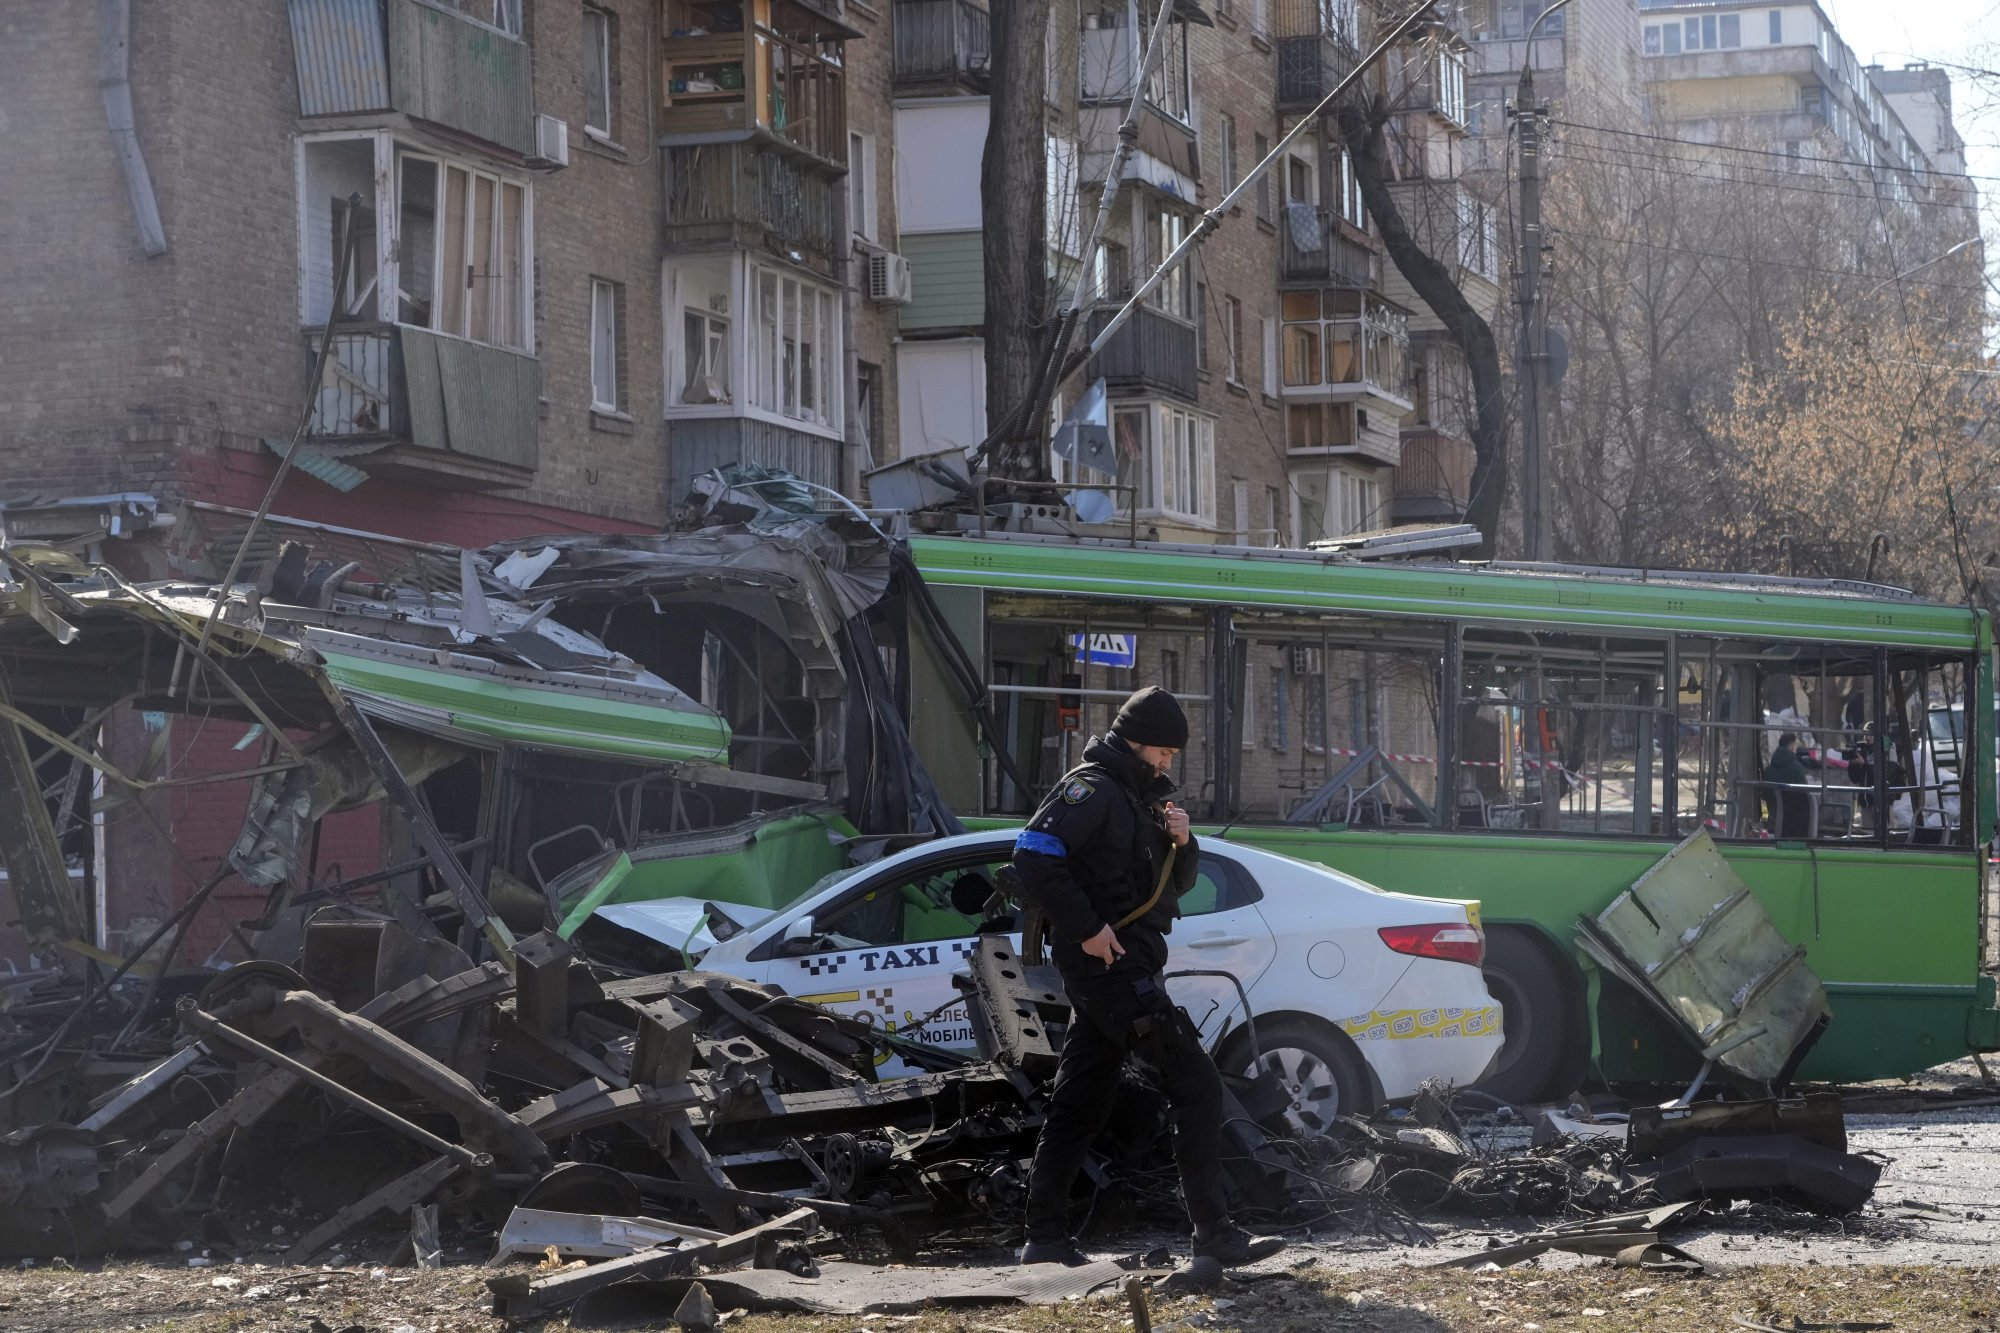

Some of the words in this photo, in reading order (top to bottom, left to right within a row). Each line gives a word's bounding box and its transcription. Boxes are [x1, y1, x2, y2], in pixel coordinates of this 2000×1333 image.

[858, 946, 940, 972] TAXI
[1422, 1013, 1437, 1023] 808
[1397, 1021, 1411, 1031] 808
